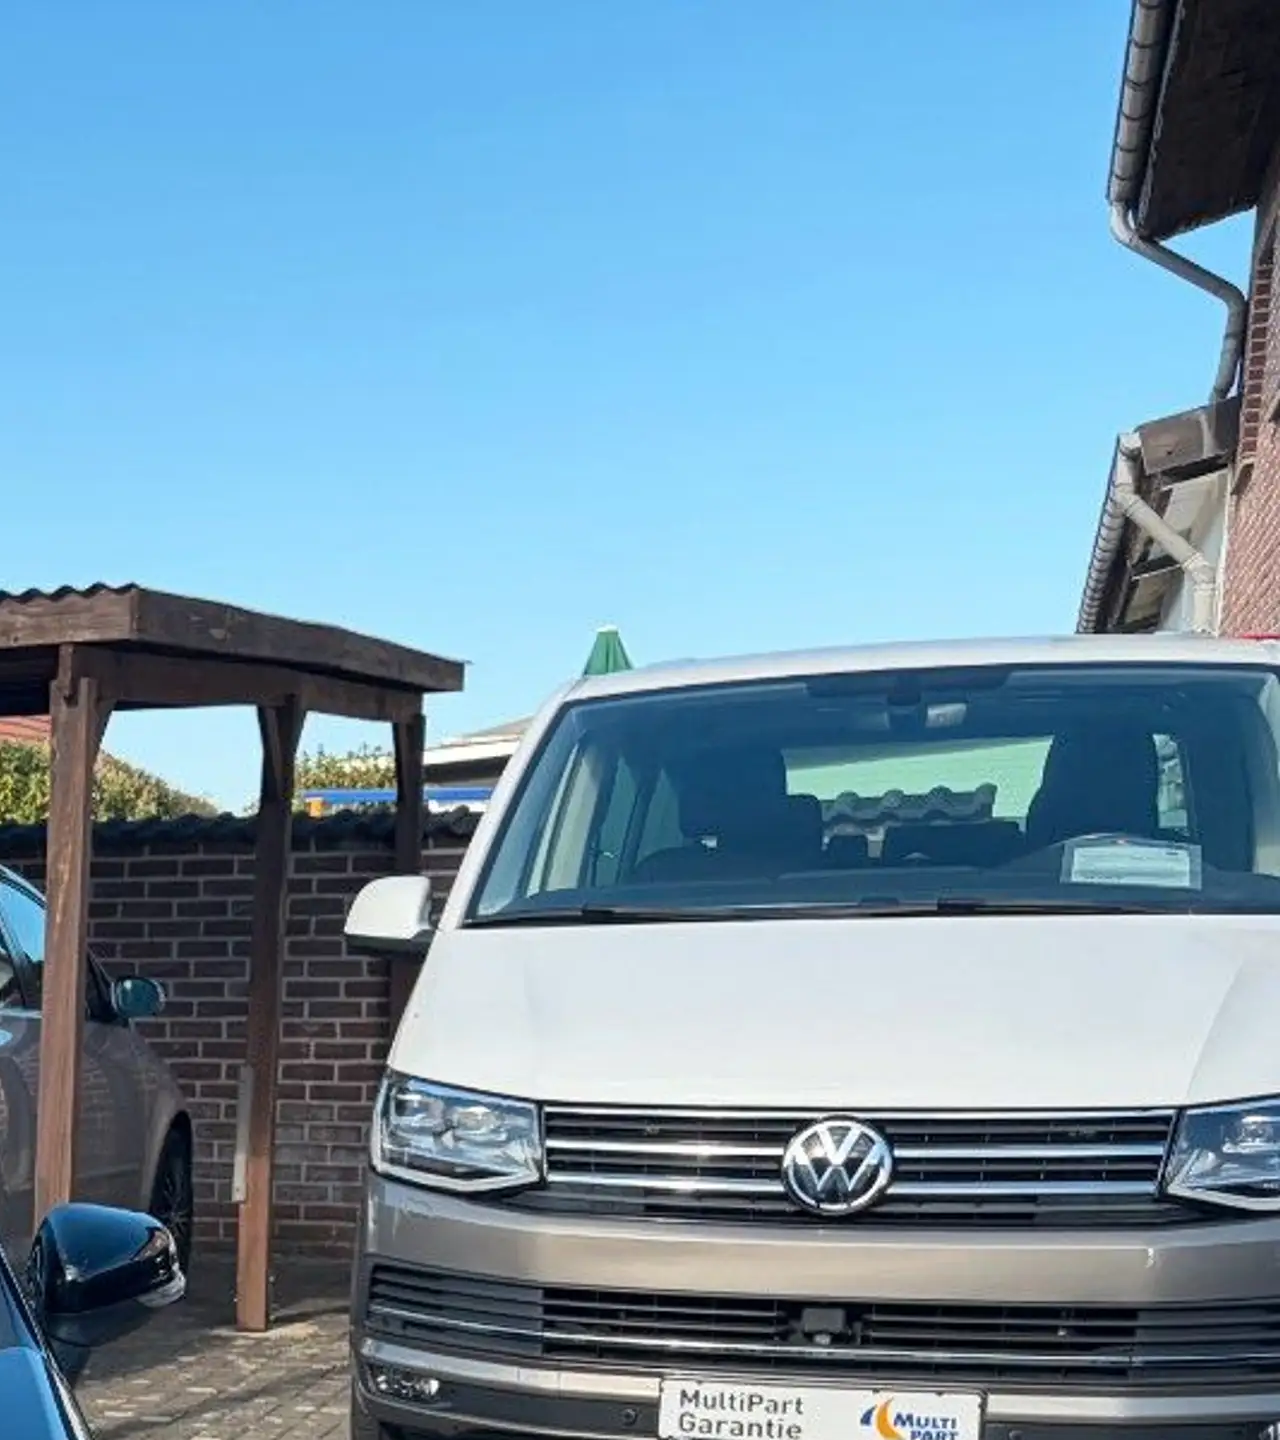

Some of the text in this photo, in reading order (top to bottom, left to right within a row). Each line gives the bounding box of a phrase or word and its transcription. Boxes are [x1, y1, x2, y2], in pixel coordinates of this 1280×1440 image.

[680, 1388, 804, 1415] MultiPart
[678, 1411, 803, 1440] Garantie
[893, 1412, 958, 1429] MULTI
